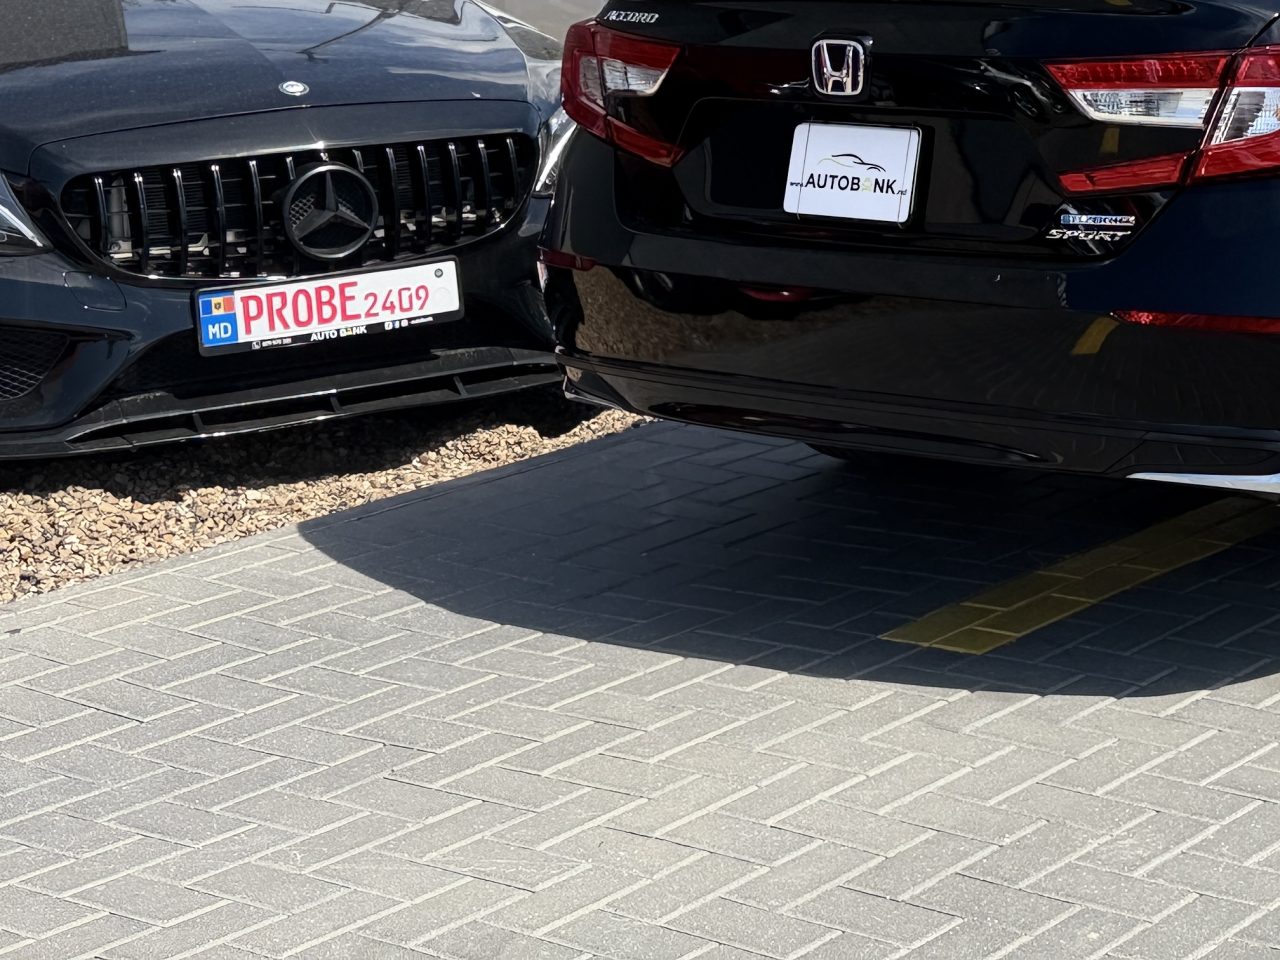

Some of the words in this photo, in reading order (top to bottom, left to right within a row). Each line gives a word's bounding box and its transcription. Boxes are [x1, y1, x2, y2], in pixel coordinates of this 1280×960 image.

[603, 10, 660, 24] ACCORD
[1045, 229, 1132, 242] SPORT
[240, 281, 362, 336] PROBE
[207, 321, 232, 340] MD
[310, 330, 338, 342] AUTO
